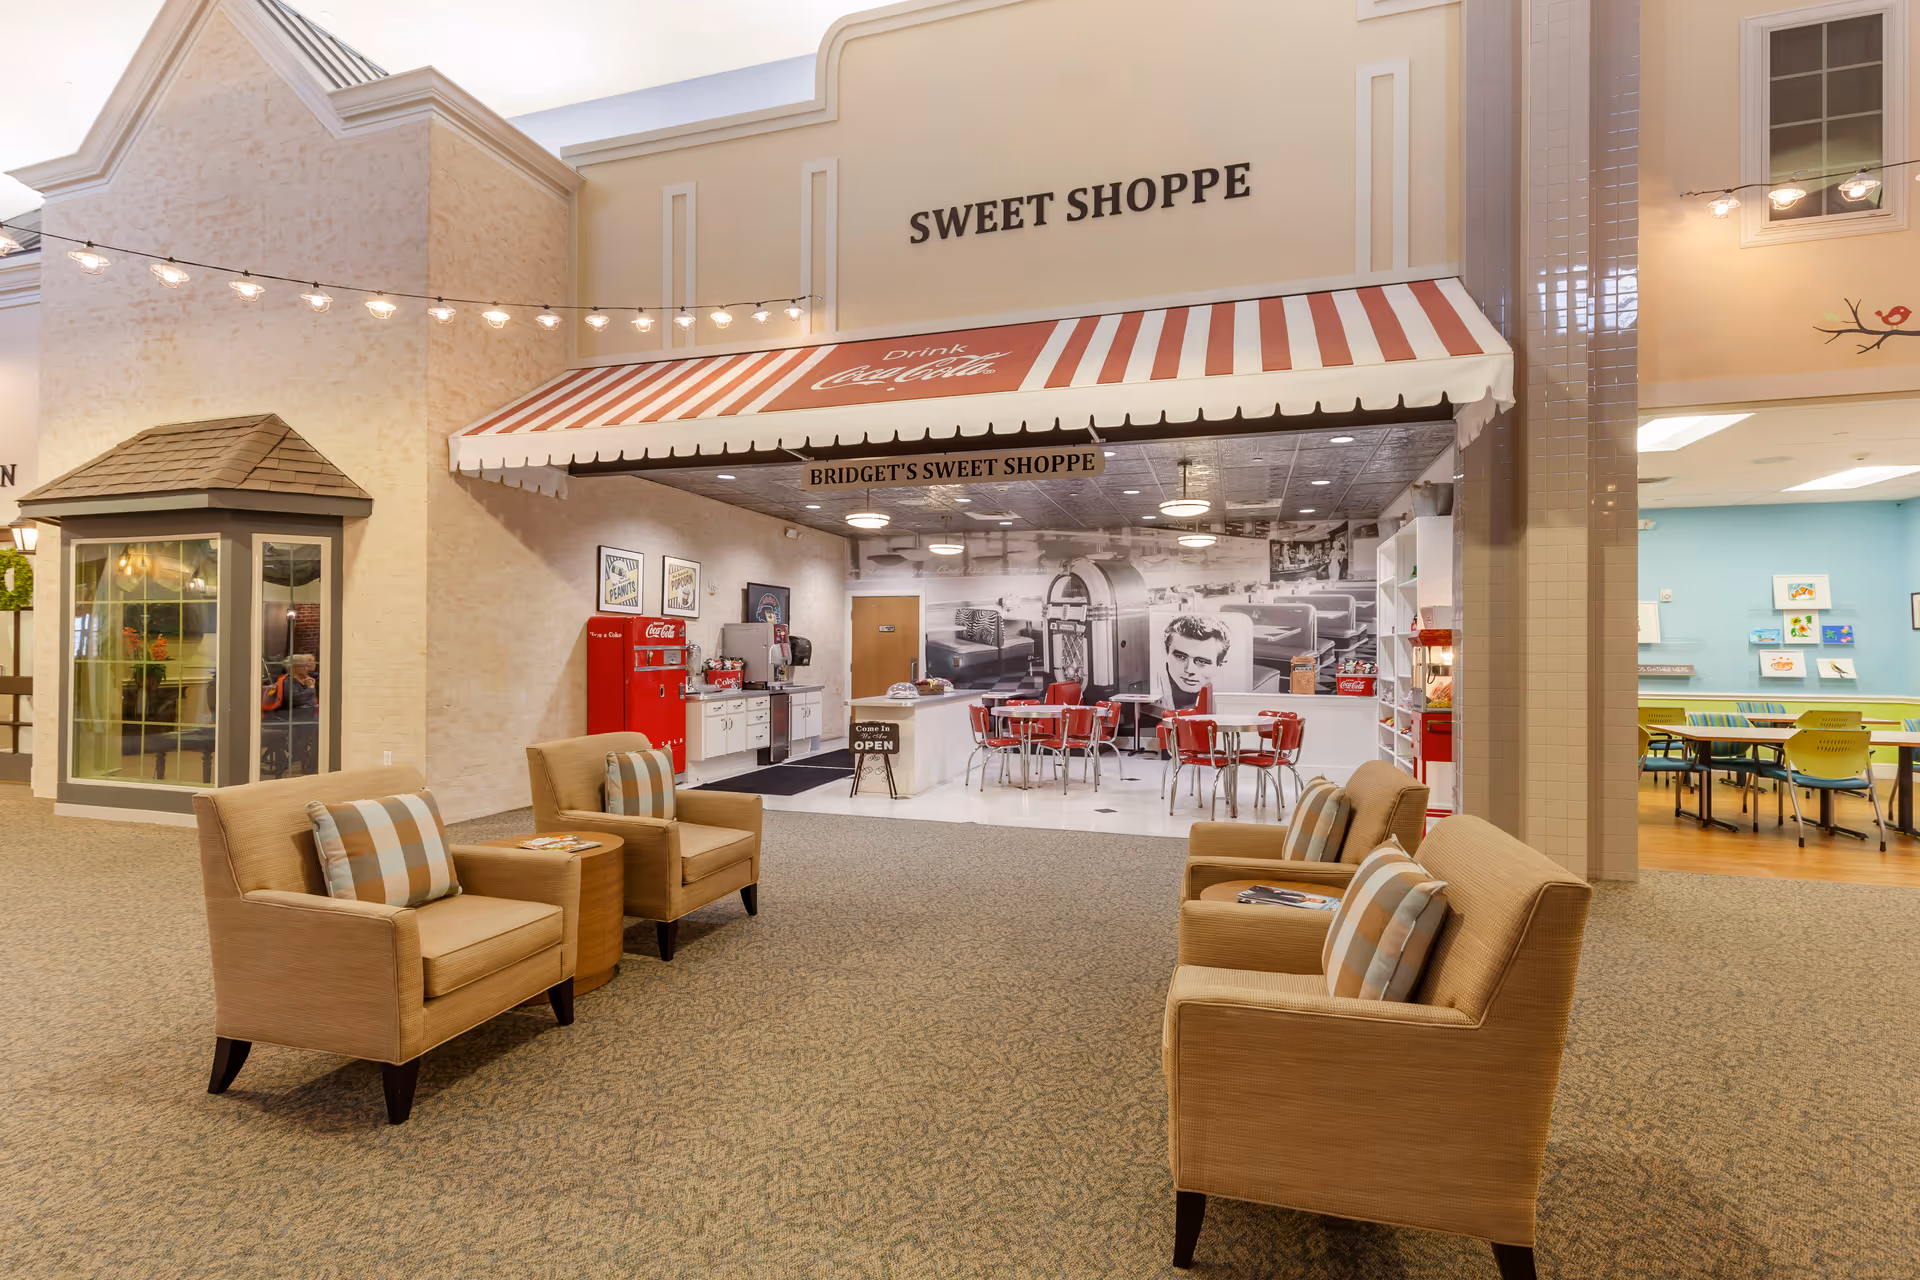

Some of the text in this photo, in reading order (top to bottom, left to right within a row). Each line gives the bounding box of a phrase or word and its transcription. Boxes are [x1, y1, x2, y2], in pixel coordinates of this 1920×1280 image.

[910, 162, 1251, 244] SWEET SHOPPE
[882, 343, 969, 361] Drink
[810, 351, 1013, 390] Coca-Cola
[810, 452, 1096, 485] BRIDGET'S SWEET SHOPPE
[609, 580, 636, 602] PEANUTS
[671, 573, 694, 591] POPCORN
[645, 624, 676, 638] Coca-Cola
[714, 677, 736, 688] Coke
[1340, 680, 1366, 689] Coca-Cola
[661, 737, 683, 746] COLD
[854, 740, 894, 750] OPEN
